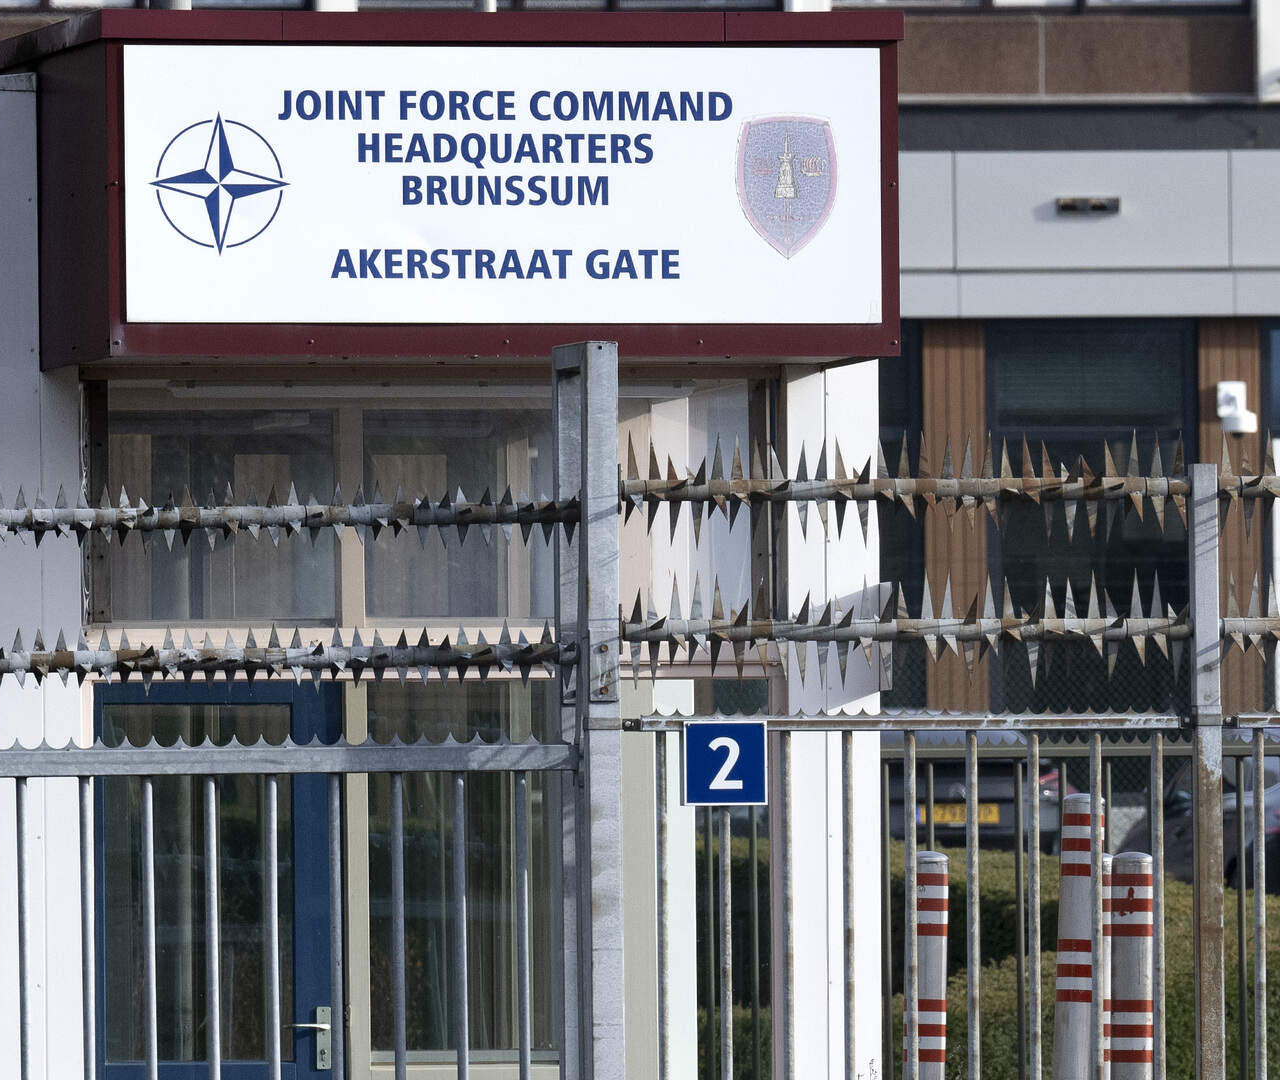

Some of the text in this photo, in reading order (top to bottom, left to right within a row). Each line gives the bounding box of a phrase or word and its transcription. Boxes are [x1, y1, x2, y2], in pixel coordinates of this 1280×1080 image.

[278, 90, 733, 121] JOINT FORCE COMMAND
[357, 133, 654, 168] HEADQUARTERS
[401, 175, 610, 206] BRUNSSUM
[331, 248, 681, 280] AKERSTRAAT GATE
[708, 736, 743, 790] 2
